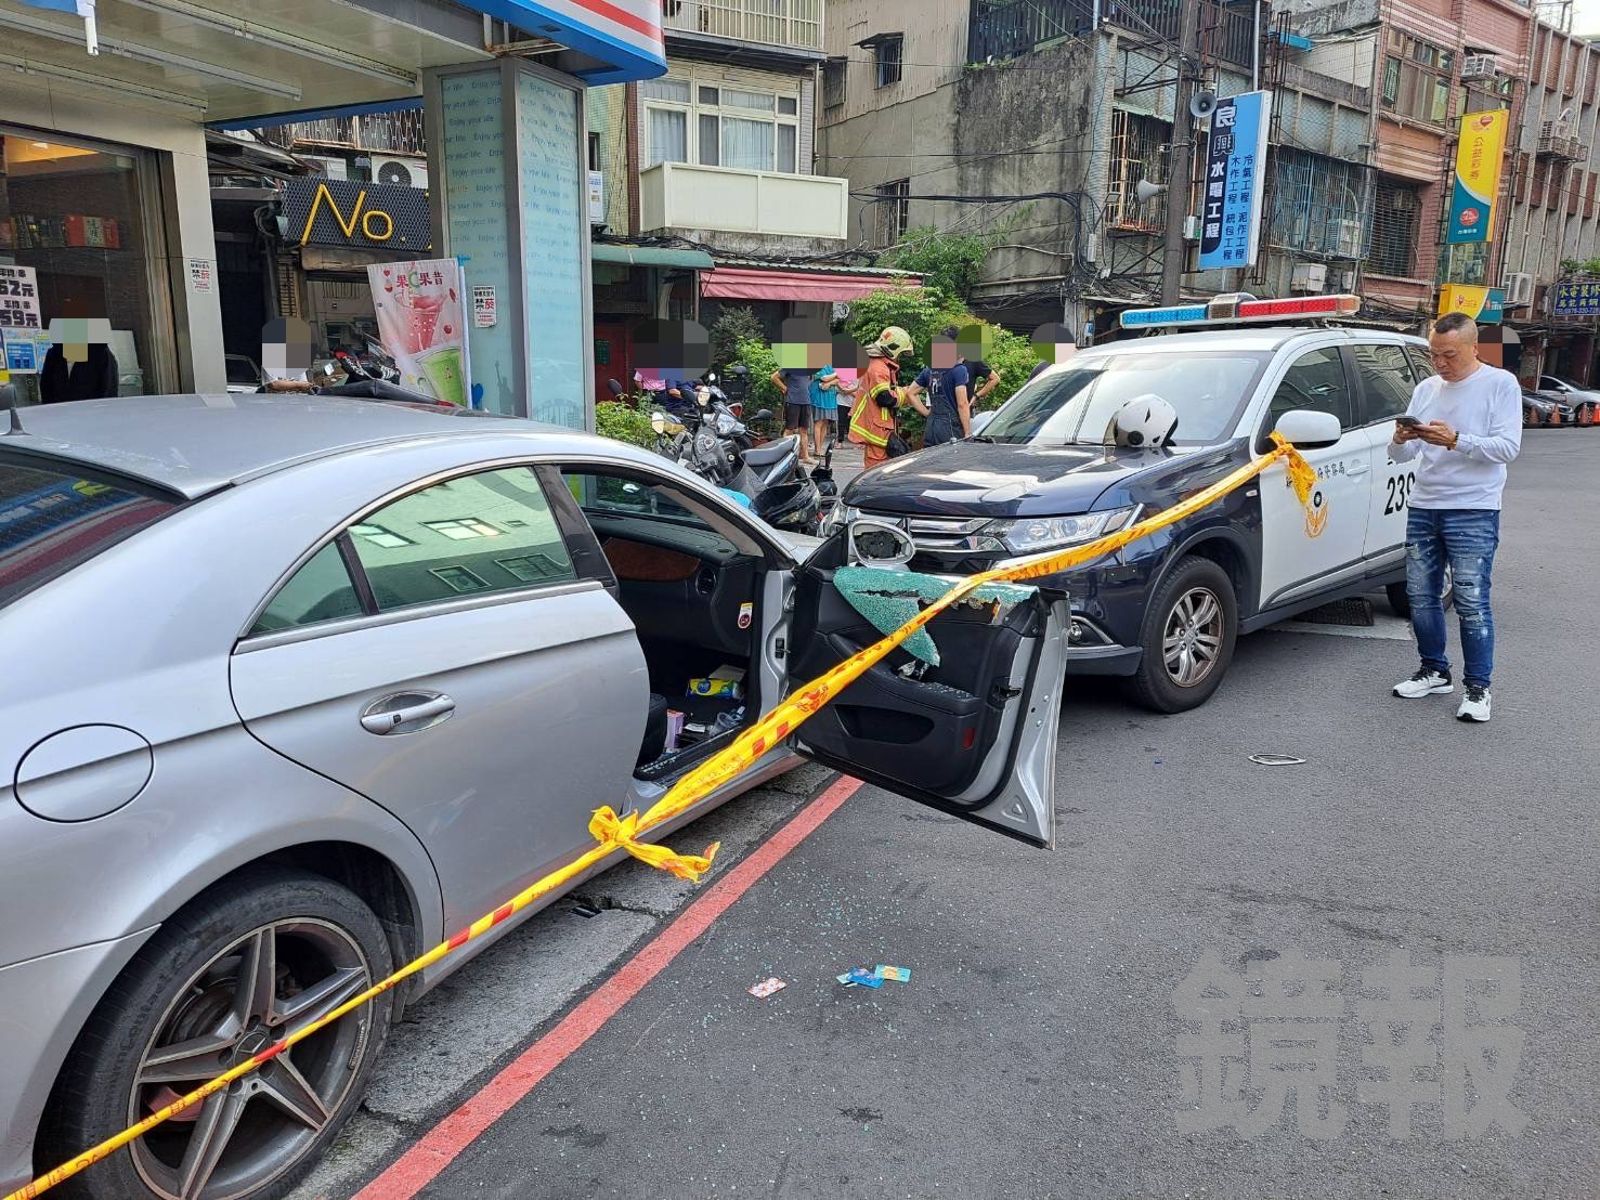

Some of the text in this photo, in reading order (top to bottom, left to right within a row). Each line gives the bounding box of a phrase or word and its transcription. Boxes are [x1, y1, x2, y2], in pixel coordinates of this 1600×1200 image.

[1205, 105, 1237, 239] 良興水電工程
